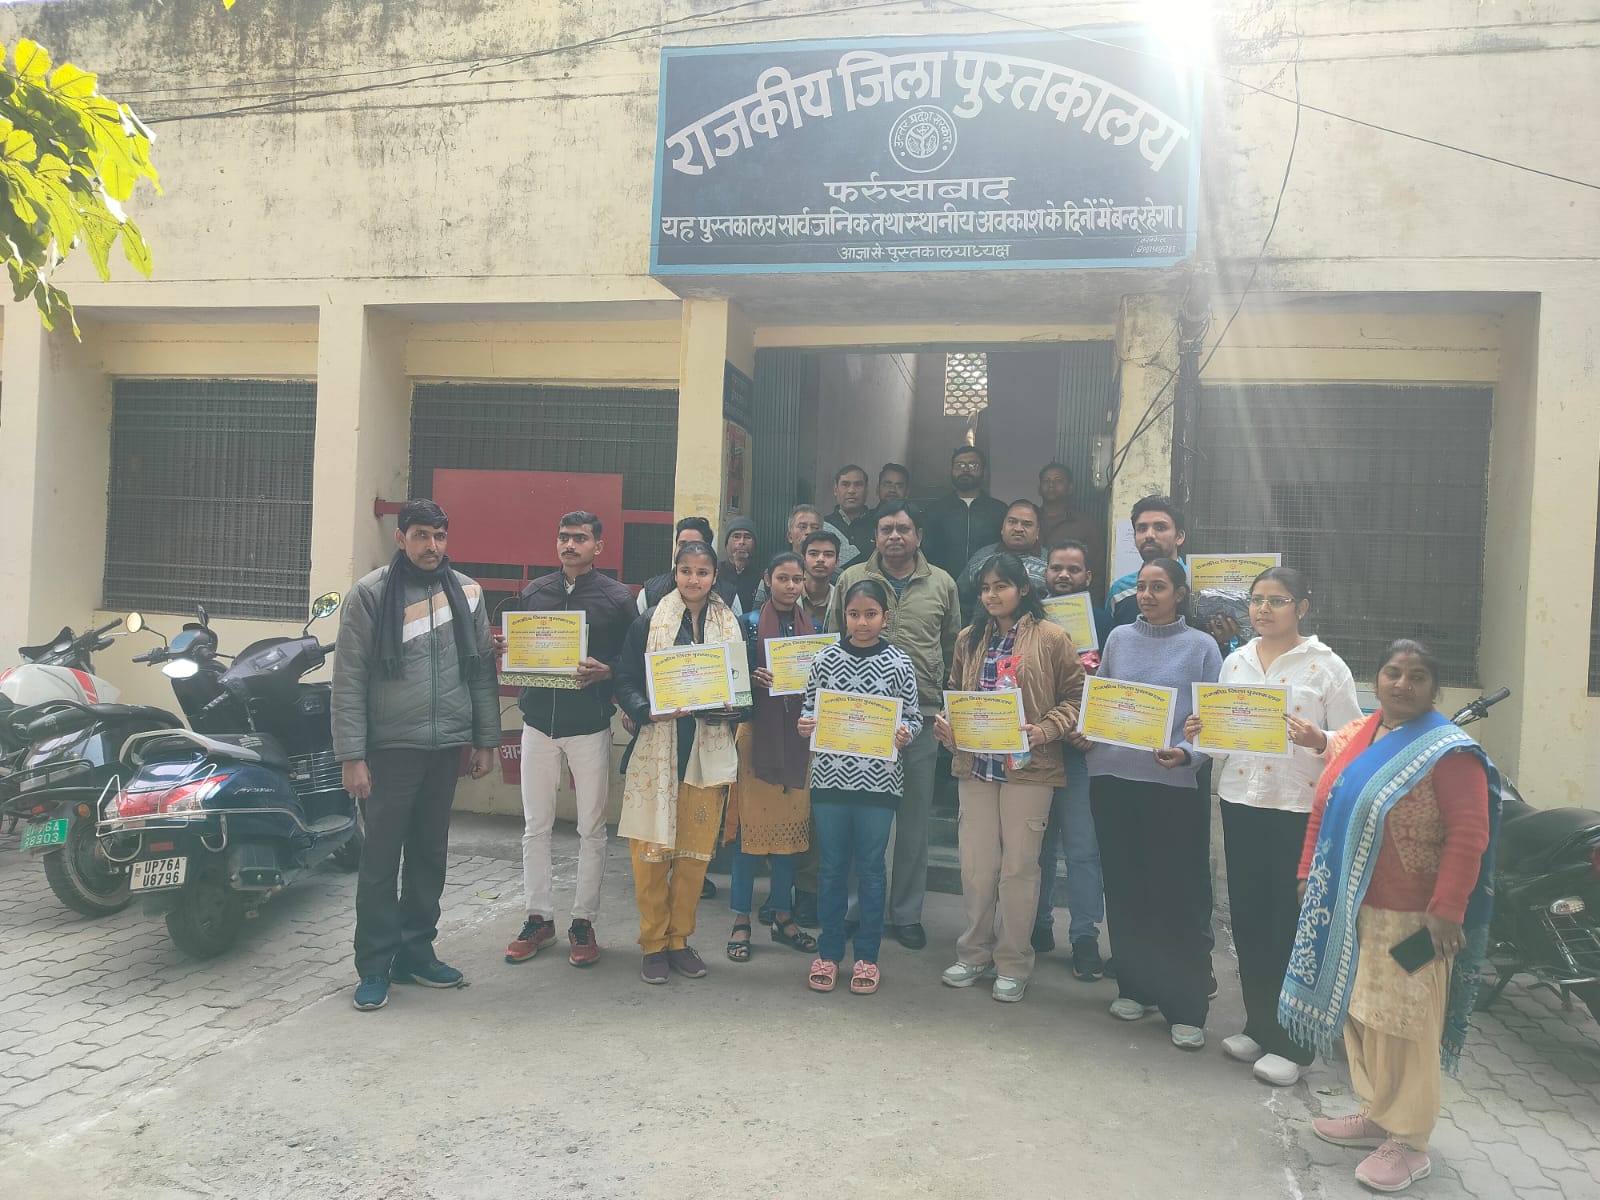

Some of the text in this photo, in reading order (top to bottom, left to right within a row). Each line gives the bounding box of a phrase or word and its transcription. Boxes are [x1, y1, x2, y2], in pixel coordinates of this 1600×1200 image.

[665, 50, 1191, 176] राजकीय जिला पुस्तकालय
[823, 171, 1016, 205] फर्रुखाबाद
[661, 216, 696, 242] यह
[698, 215, 778, 243] पुस्तकालय
[777, 207, 872, 238] सार्वजनिक
[871, 212, 904, 236] तथा
[904, 202, 974, 236] स्थानीय
[975, 208, 1046, 234] अवकाश
[1046, 200, 1063, 233] के
[142, 871, 180, 887] U8796
[144, 859, 180, 874] UP76A
